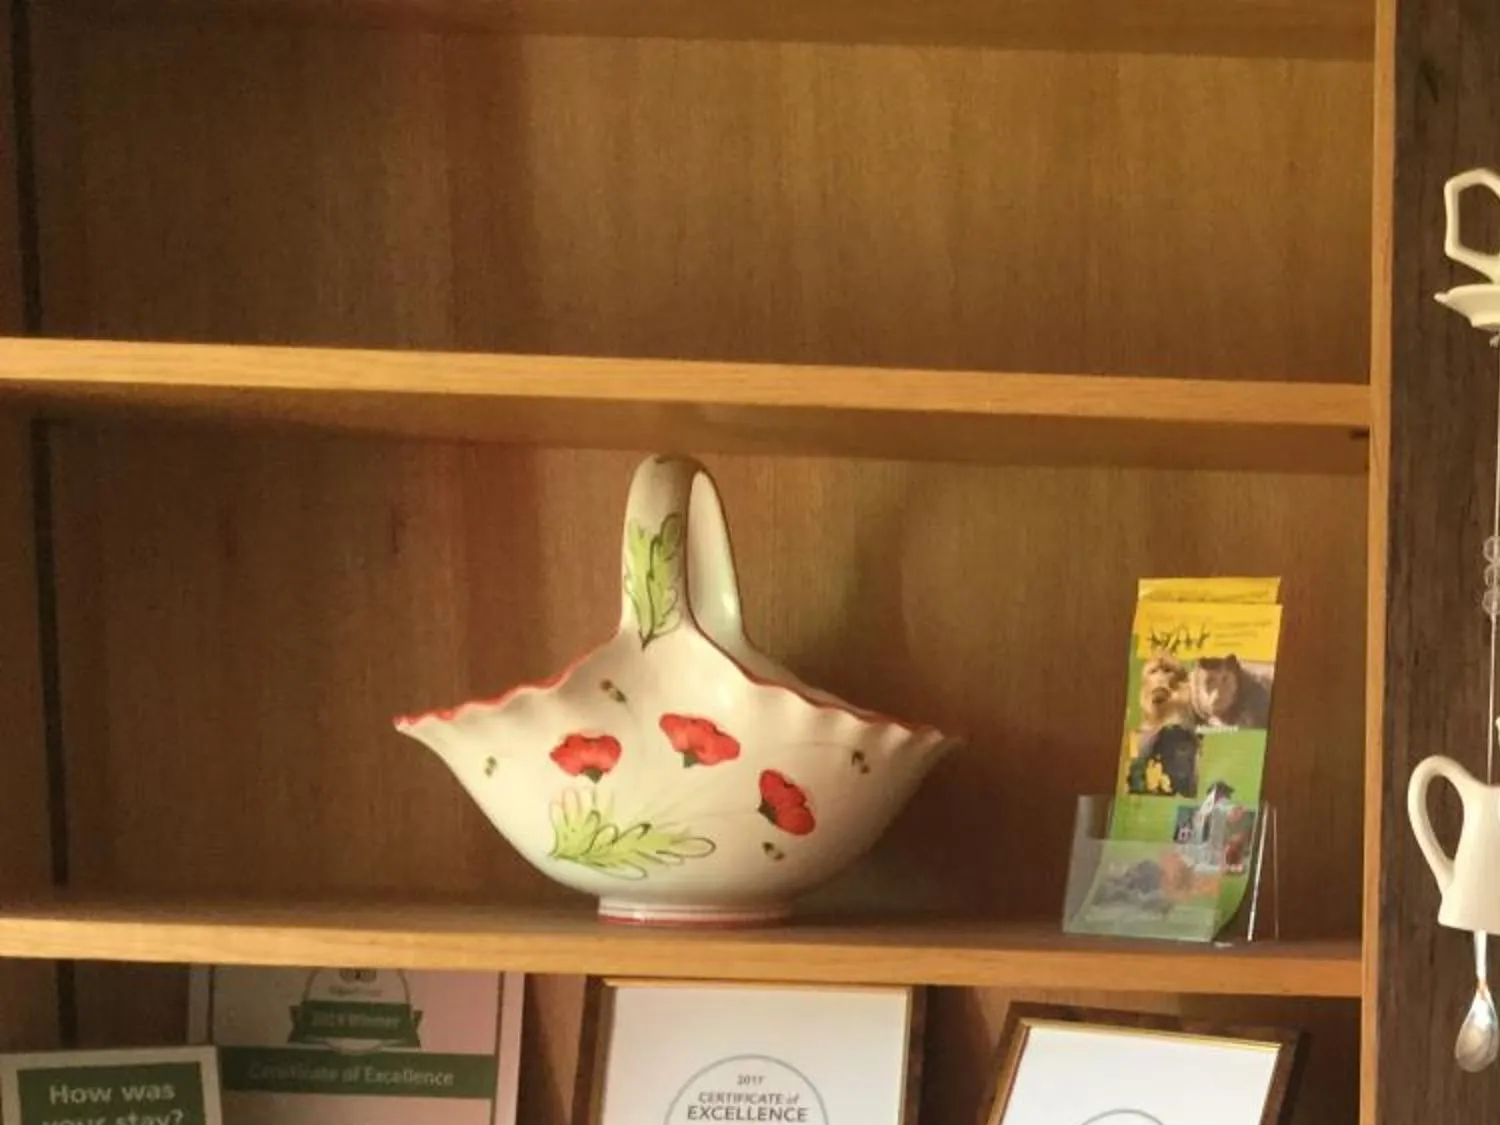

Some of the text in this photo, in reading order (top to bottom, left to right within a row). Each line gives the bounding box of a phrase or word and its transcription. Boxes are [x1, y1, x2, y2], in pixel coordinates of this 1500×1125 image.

[364, 1065, 455, 1087] Excellence
[49, 1082, 176, 1105] How was
[698, 1091, 784, 1105] CERTIFICATE
[687, 1104, 809, 1123] EXCELLENCE
